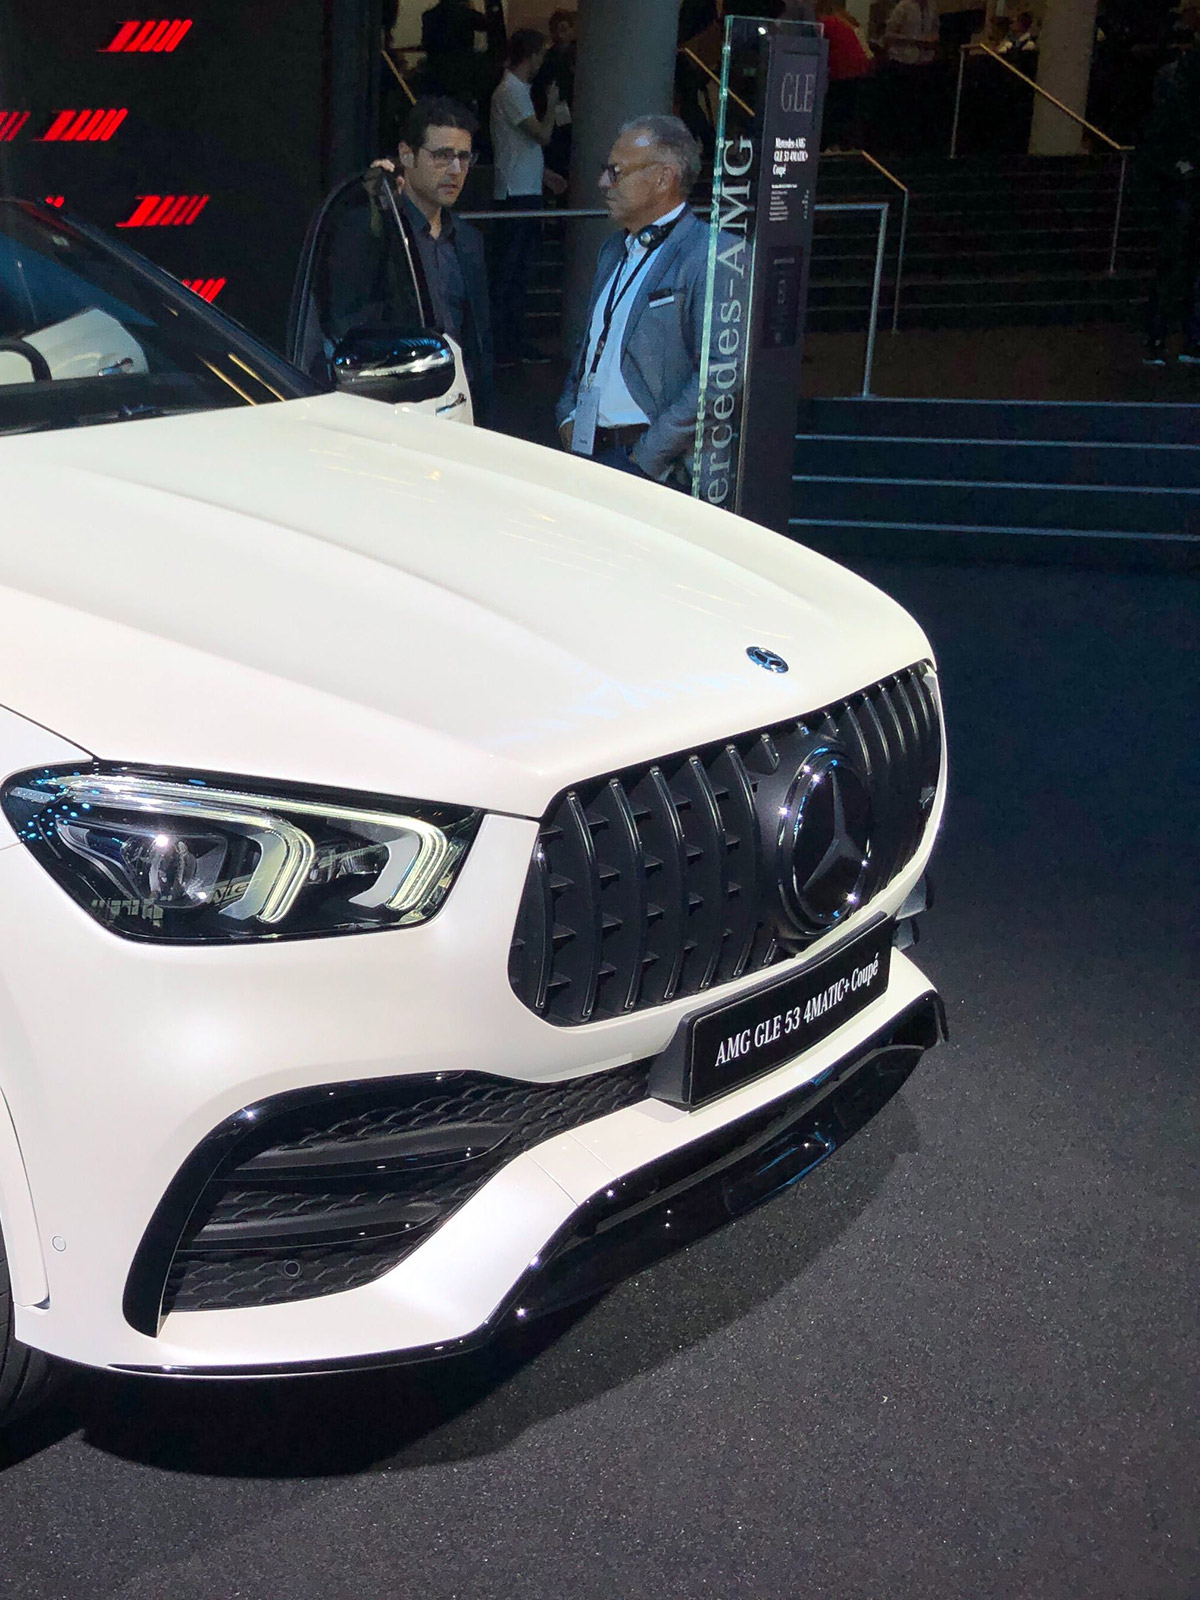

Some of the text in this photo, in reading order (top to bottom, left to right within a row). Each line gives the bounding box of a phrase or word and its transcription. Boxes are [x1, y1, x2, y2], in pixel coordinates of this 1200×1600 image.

[781, 72, 816, 113] GLE
[707, 136, 754, 508] ercedes-AMG
[714, 952, 879, 1068] AMG GLE 53 4MATIC+ Coupé
